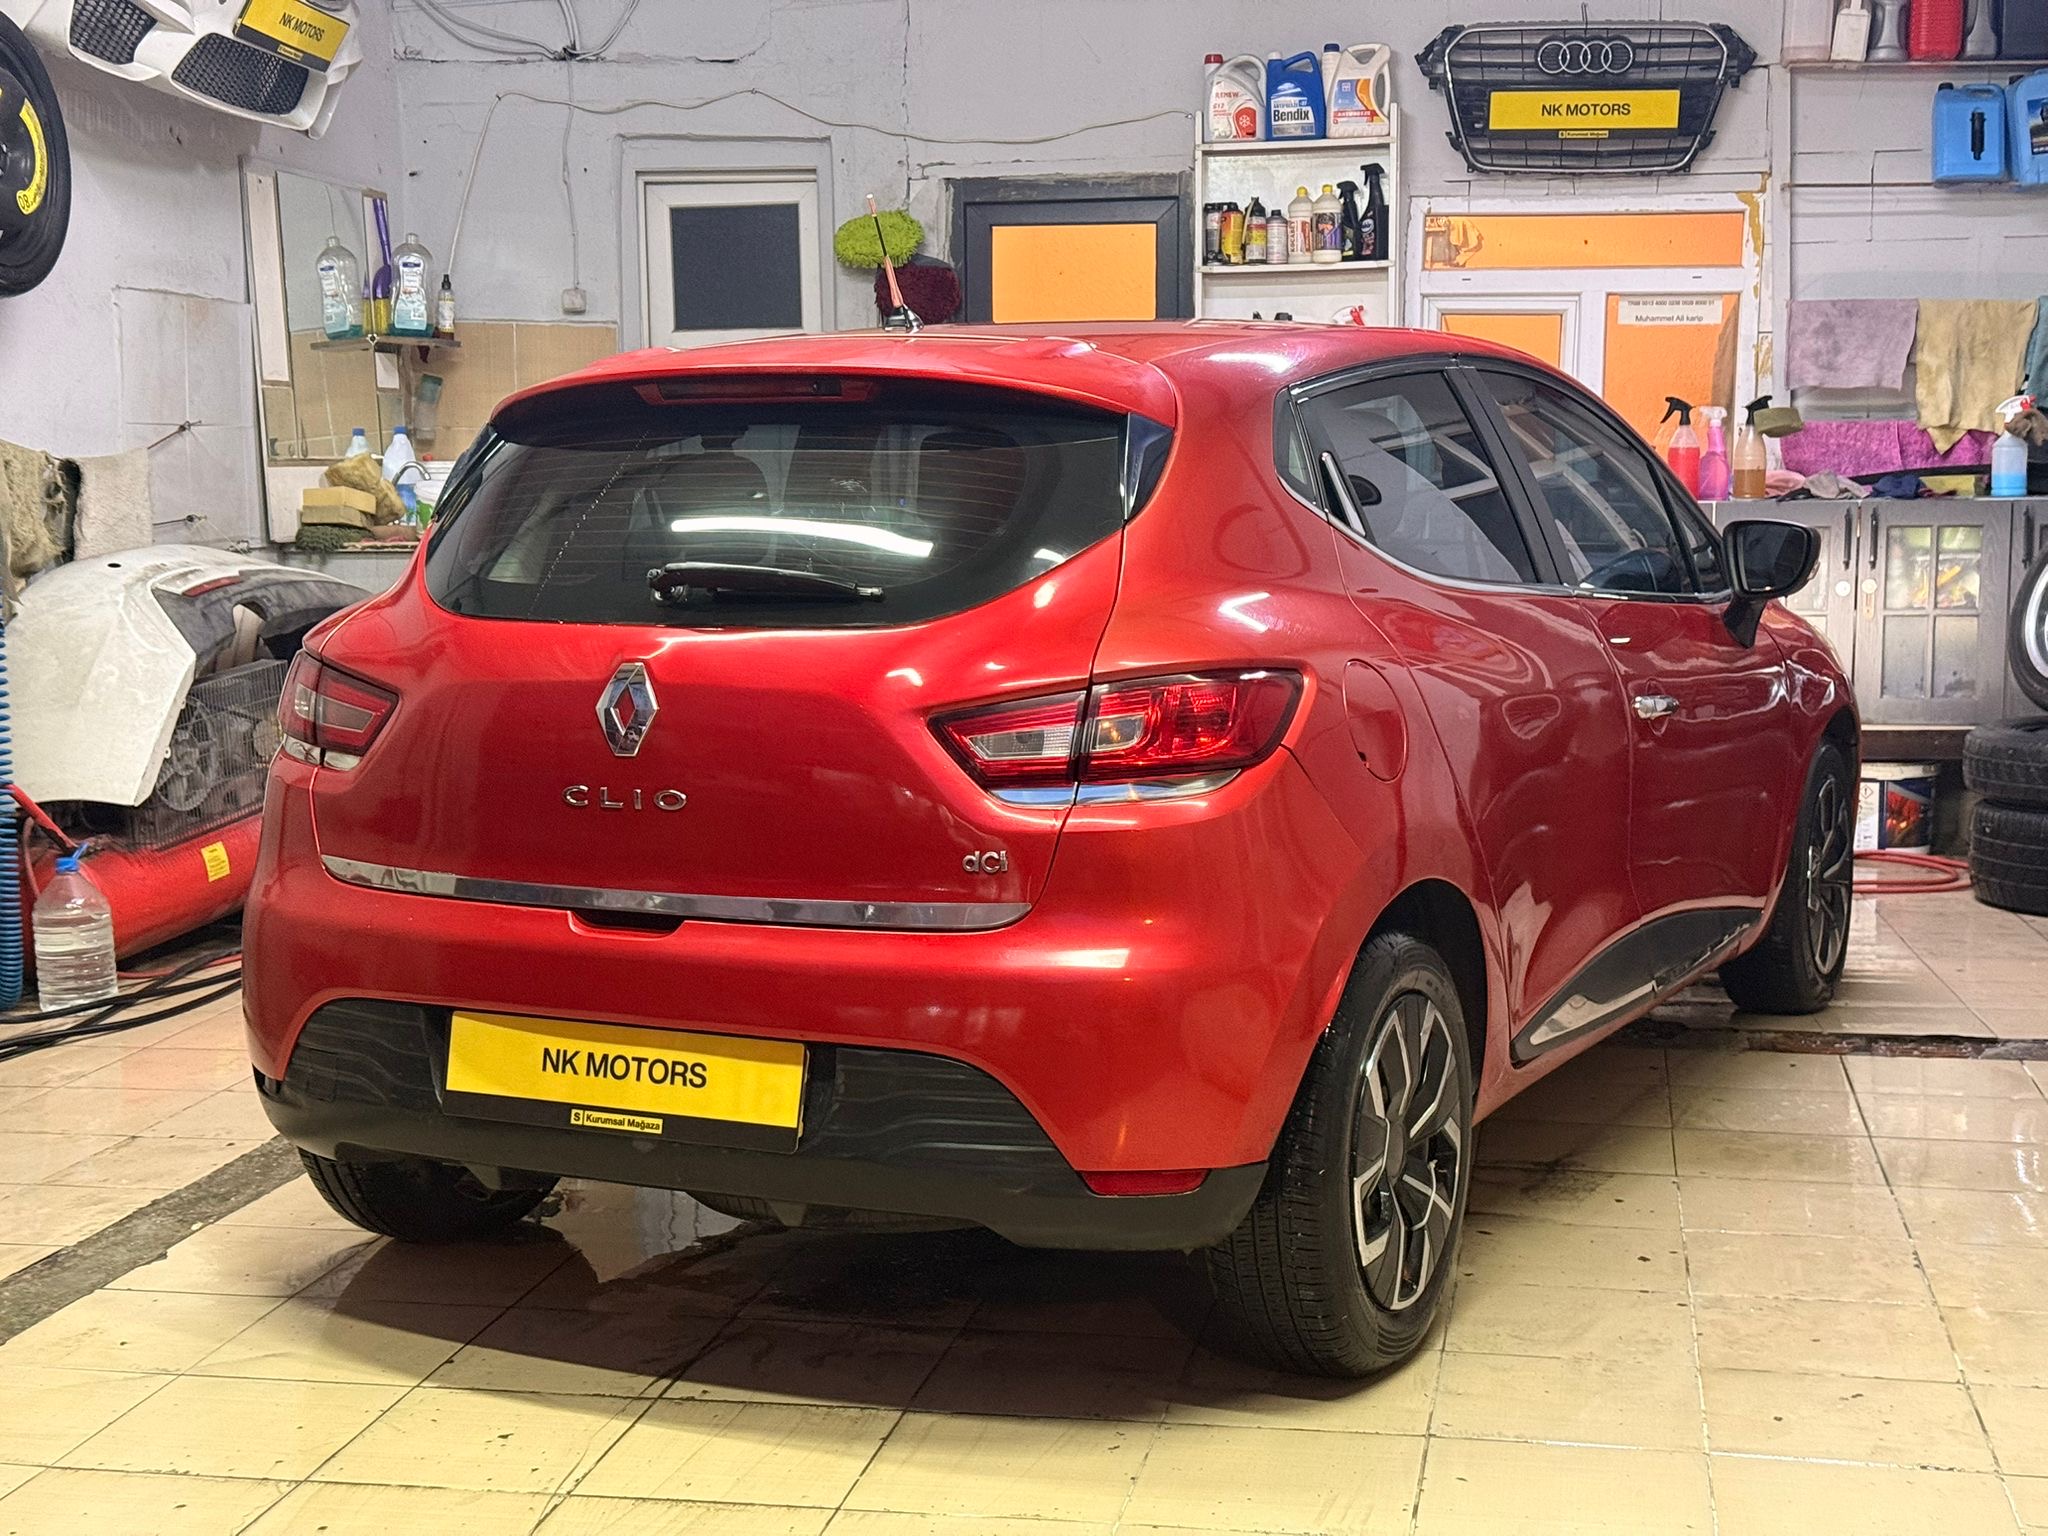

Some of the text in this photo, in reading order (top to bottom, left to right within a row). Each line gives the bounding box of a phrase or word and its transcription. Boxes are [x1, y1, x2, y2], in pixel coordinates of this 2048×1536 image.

[279, 12, 325, 42] NK MOTORS
[1273, 108, 1309, 122] Bendix
[1541, 103, 1631, 116] NK MOTORS
[562, 785, 687, 811] CLIO
[541, 1047, 708, 1089] NK MOTORS
[573, 1112, 661, 1131] S Kurumsal Mağaza
